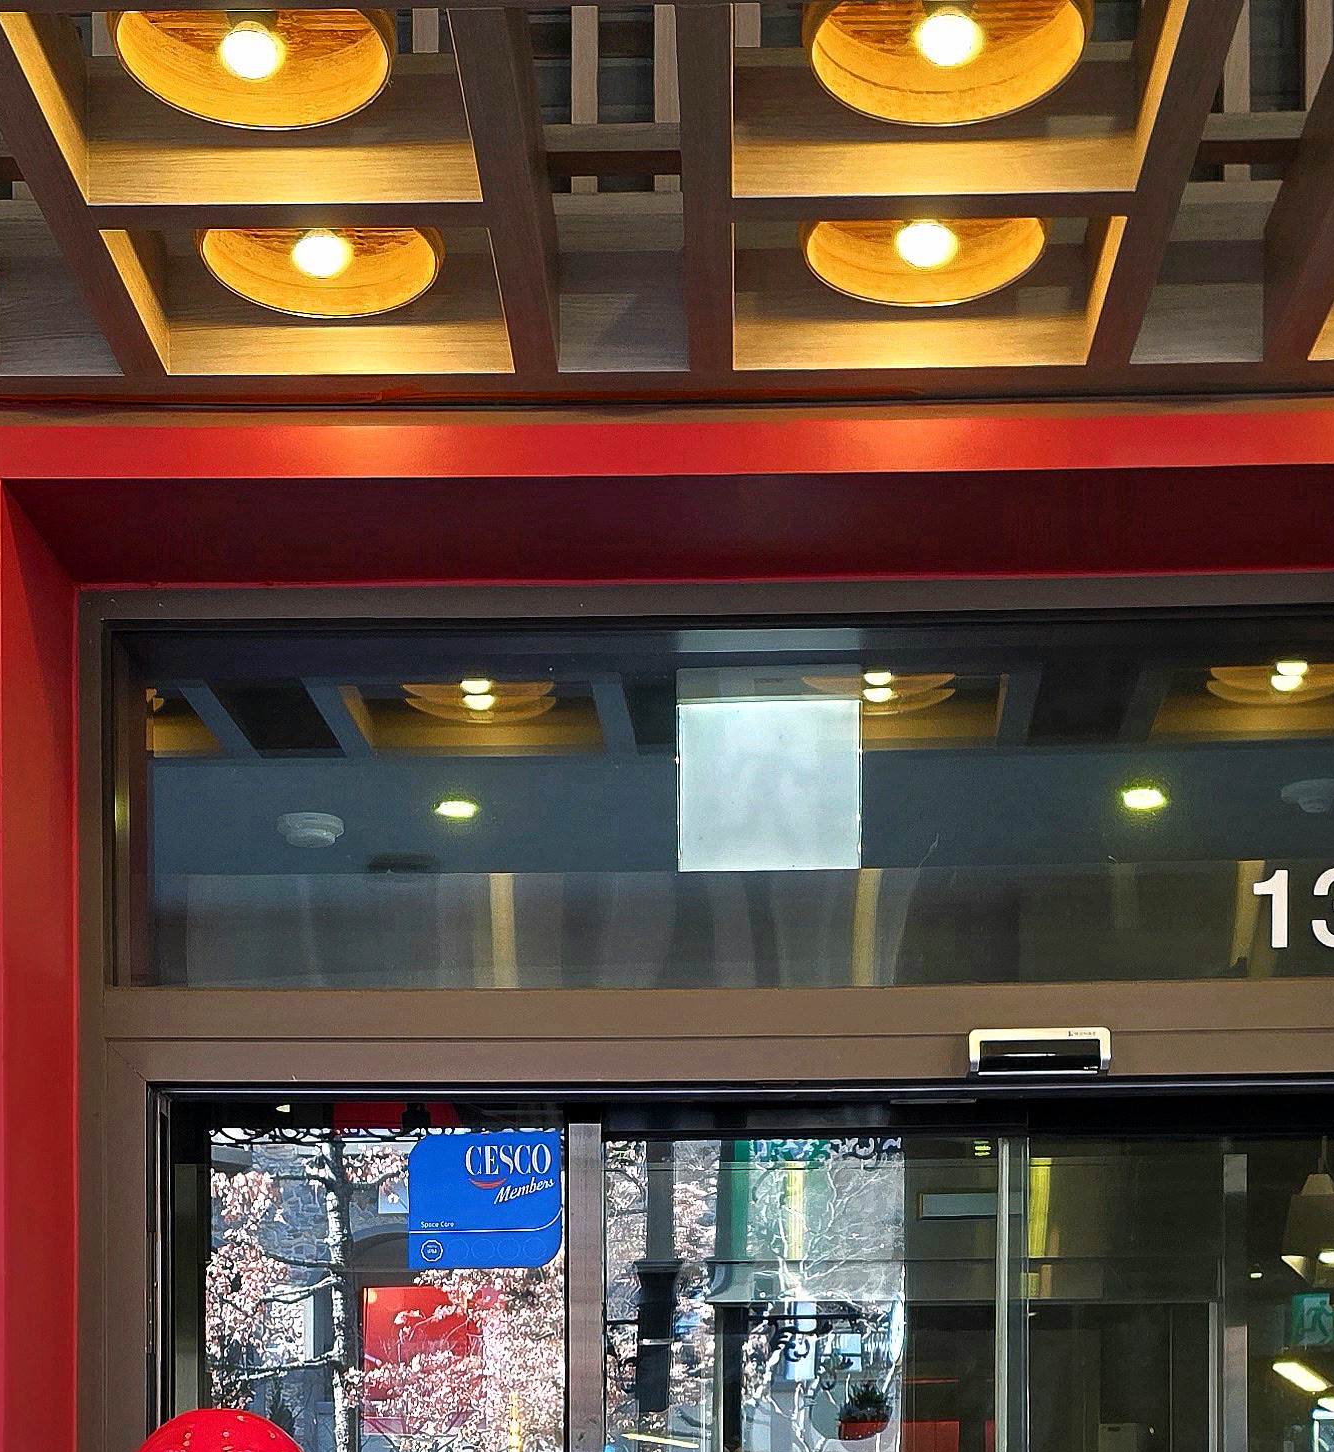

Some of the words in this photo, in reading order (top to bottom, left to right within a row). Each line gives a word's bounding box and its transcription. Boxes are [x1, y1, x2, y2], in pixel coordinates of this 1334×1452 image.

[465, 1144, 552, 1175] CESCO
[493, 1177, 555, 1204] Members
[420, 1220, 439, 1229] Space
